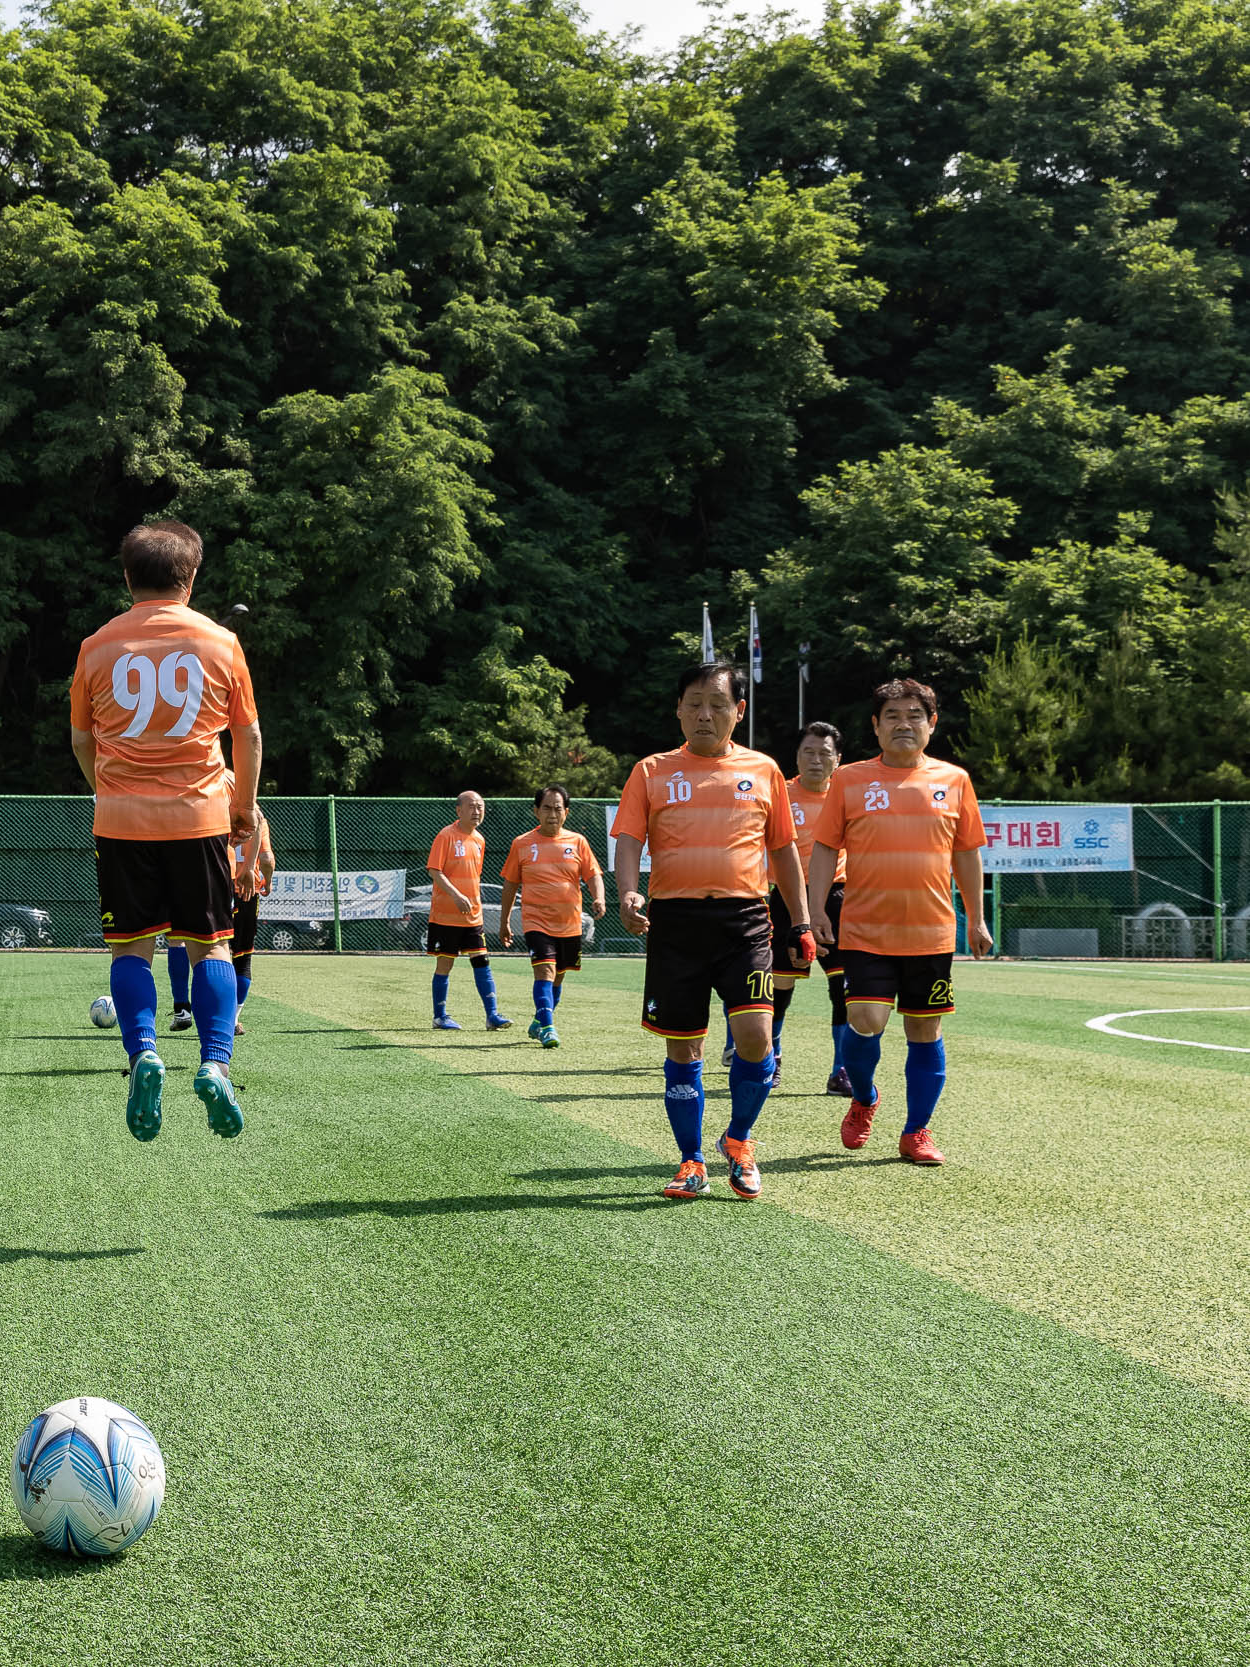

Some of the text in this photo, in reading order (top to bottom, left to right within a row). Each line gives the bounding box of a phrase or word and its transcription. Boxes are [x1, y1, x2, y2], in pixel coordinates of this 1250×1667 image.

[112, 650, 204, 738] 99
[666, 780, 692, 804] 10
[864, 789, 890, 812] 23
[1074, 837, 1110, 849] SSC
